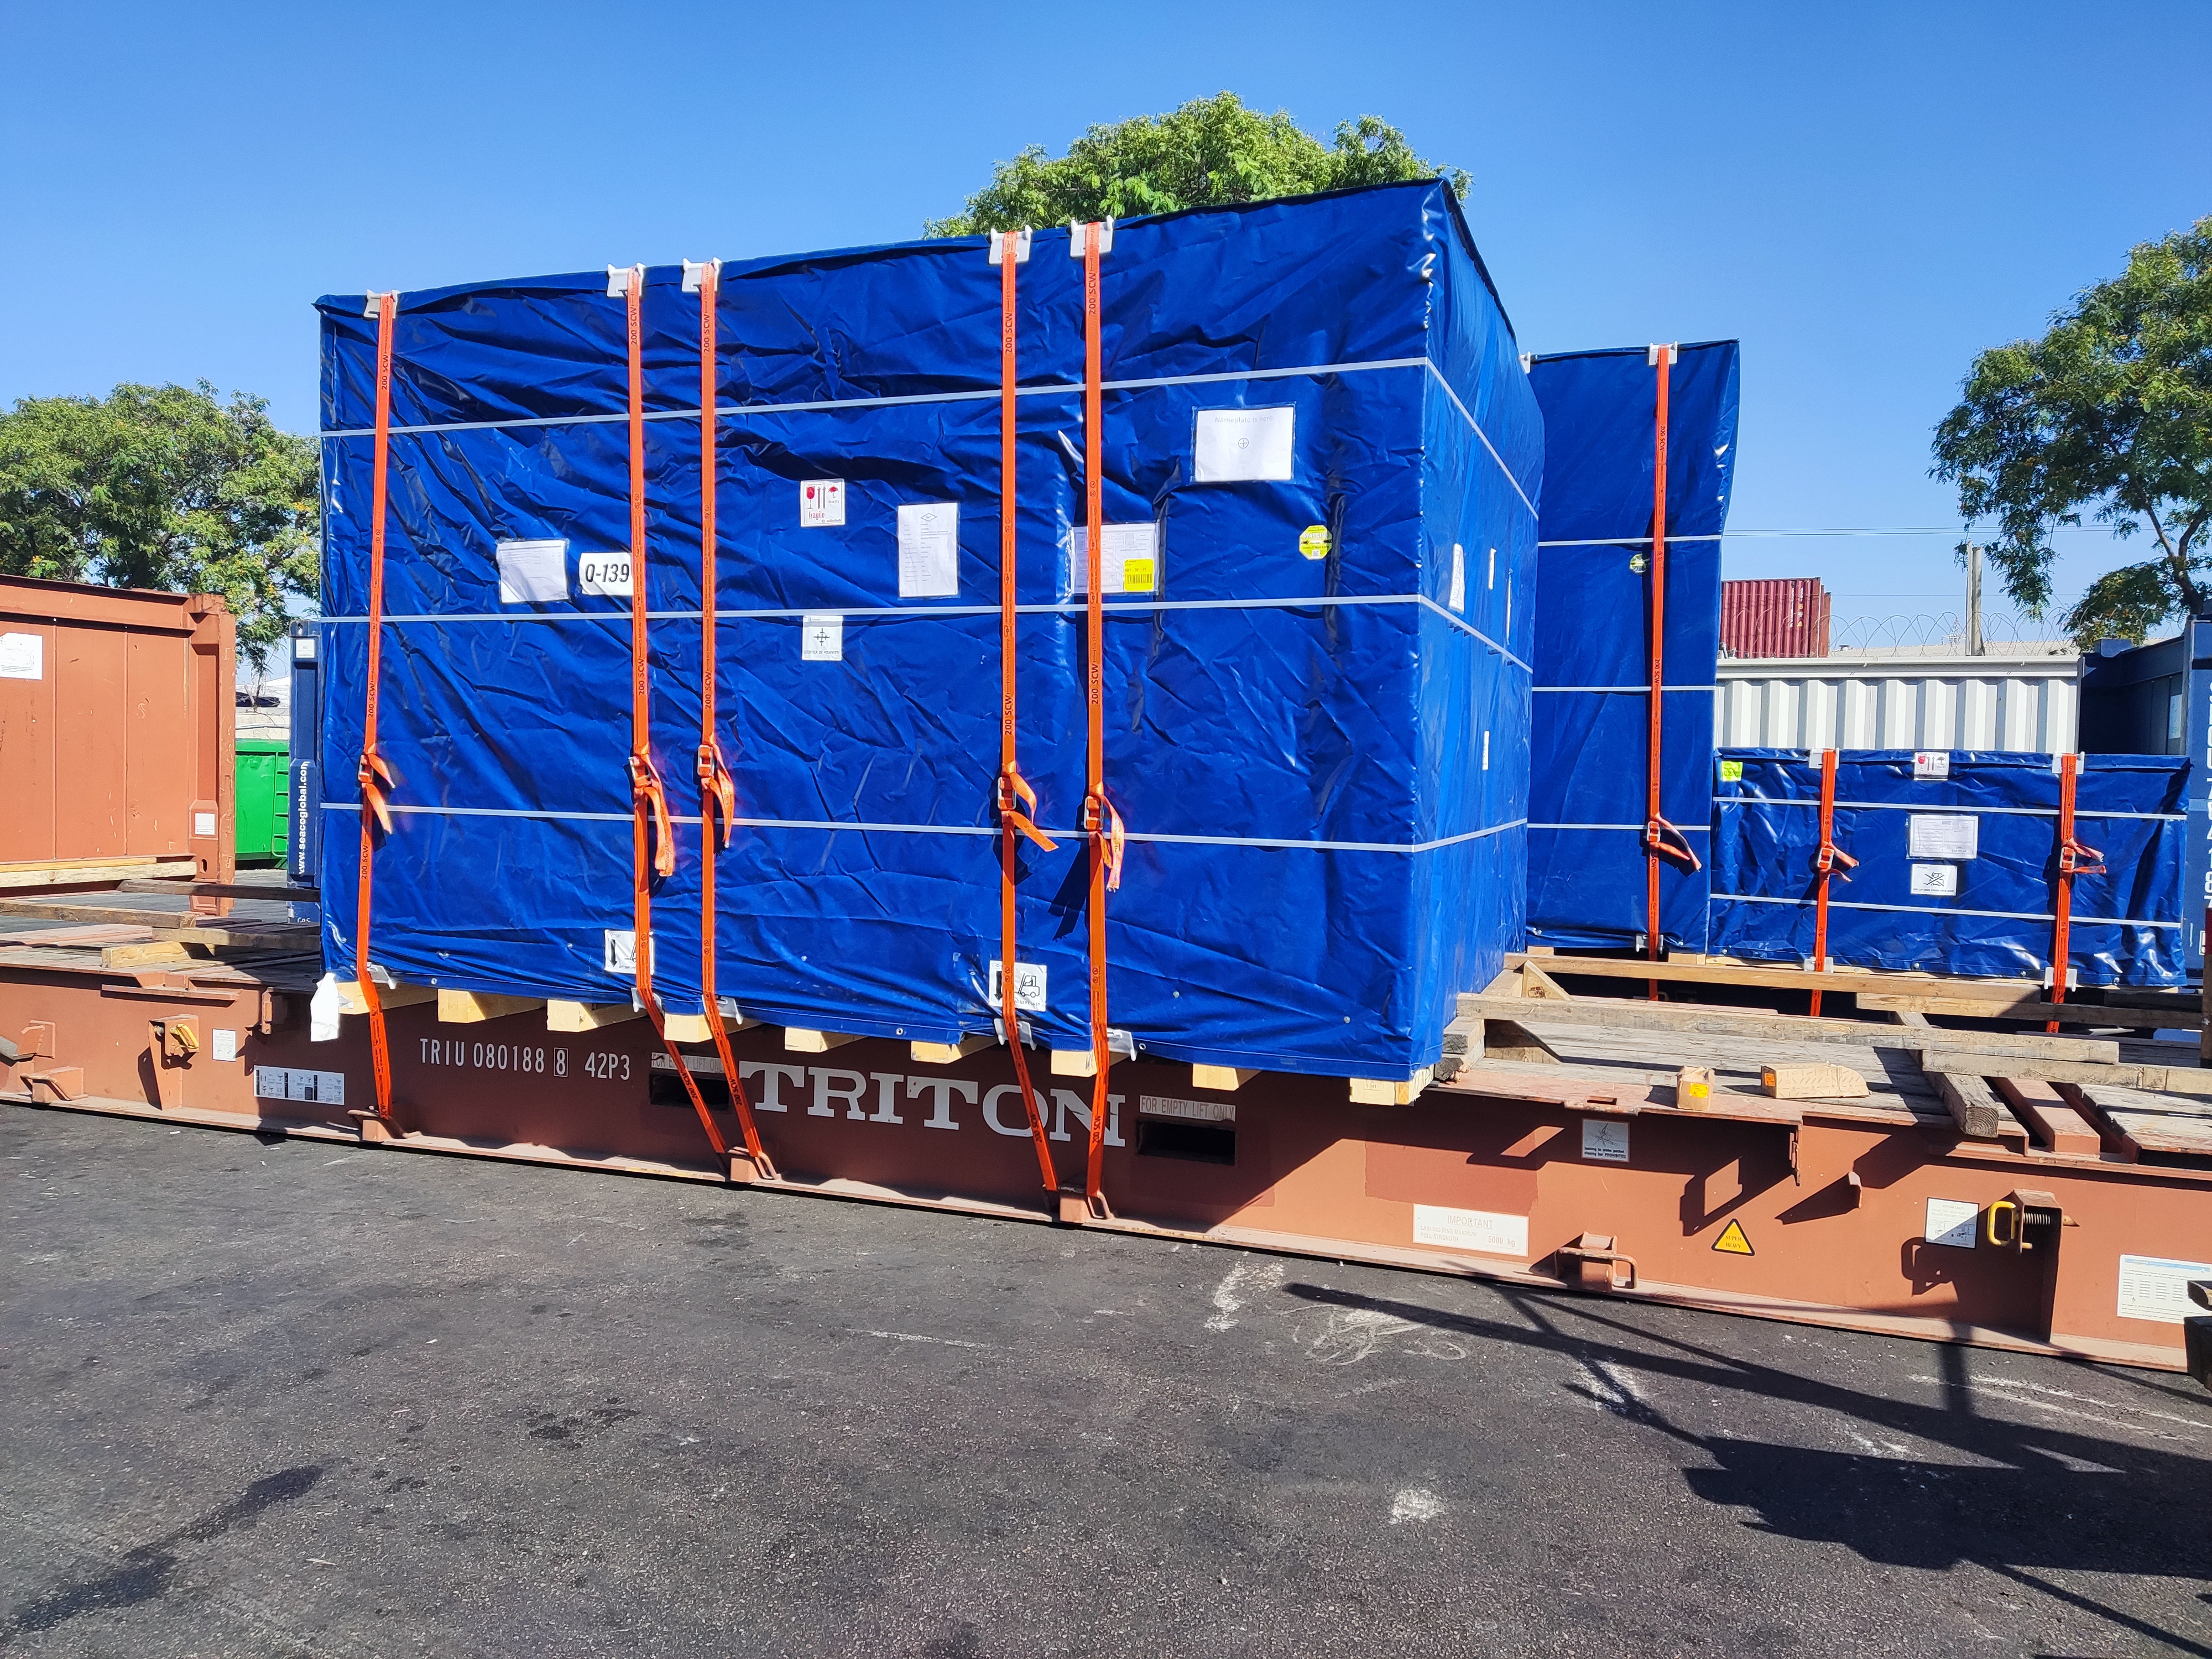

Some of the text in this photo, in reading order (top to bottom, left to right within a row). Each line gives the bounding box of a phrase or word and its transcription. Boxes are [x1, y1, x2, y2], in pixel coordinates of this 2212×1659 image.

[808, 511, 825, 520] fragile
[298, 761, 311, 876] www.seacoglobal.com
[420, 1038, 630, 1081] TRIU 080188 8 42P3
[693, 1058, 706, 1071] LIFT
[681, 1071, 697, 1100] 200 SCW
[729, 1078, 743, 1106] 200 SCW
[739, 1060, 1126, 1147] TRITON
[1141, 1097, 1235, 1119] FOR EMPTY LIFT ONLY
[1447, 1215, 1494, 1229] IMPORTANT
[1488, 1235, 1515, 1247] 5000 kg
